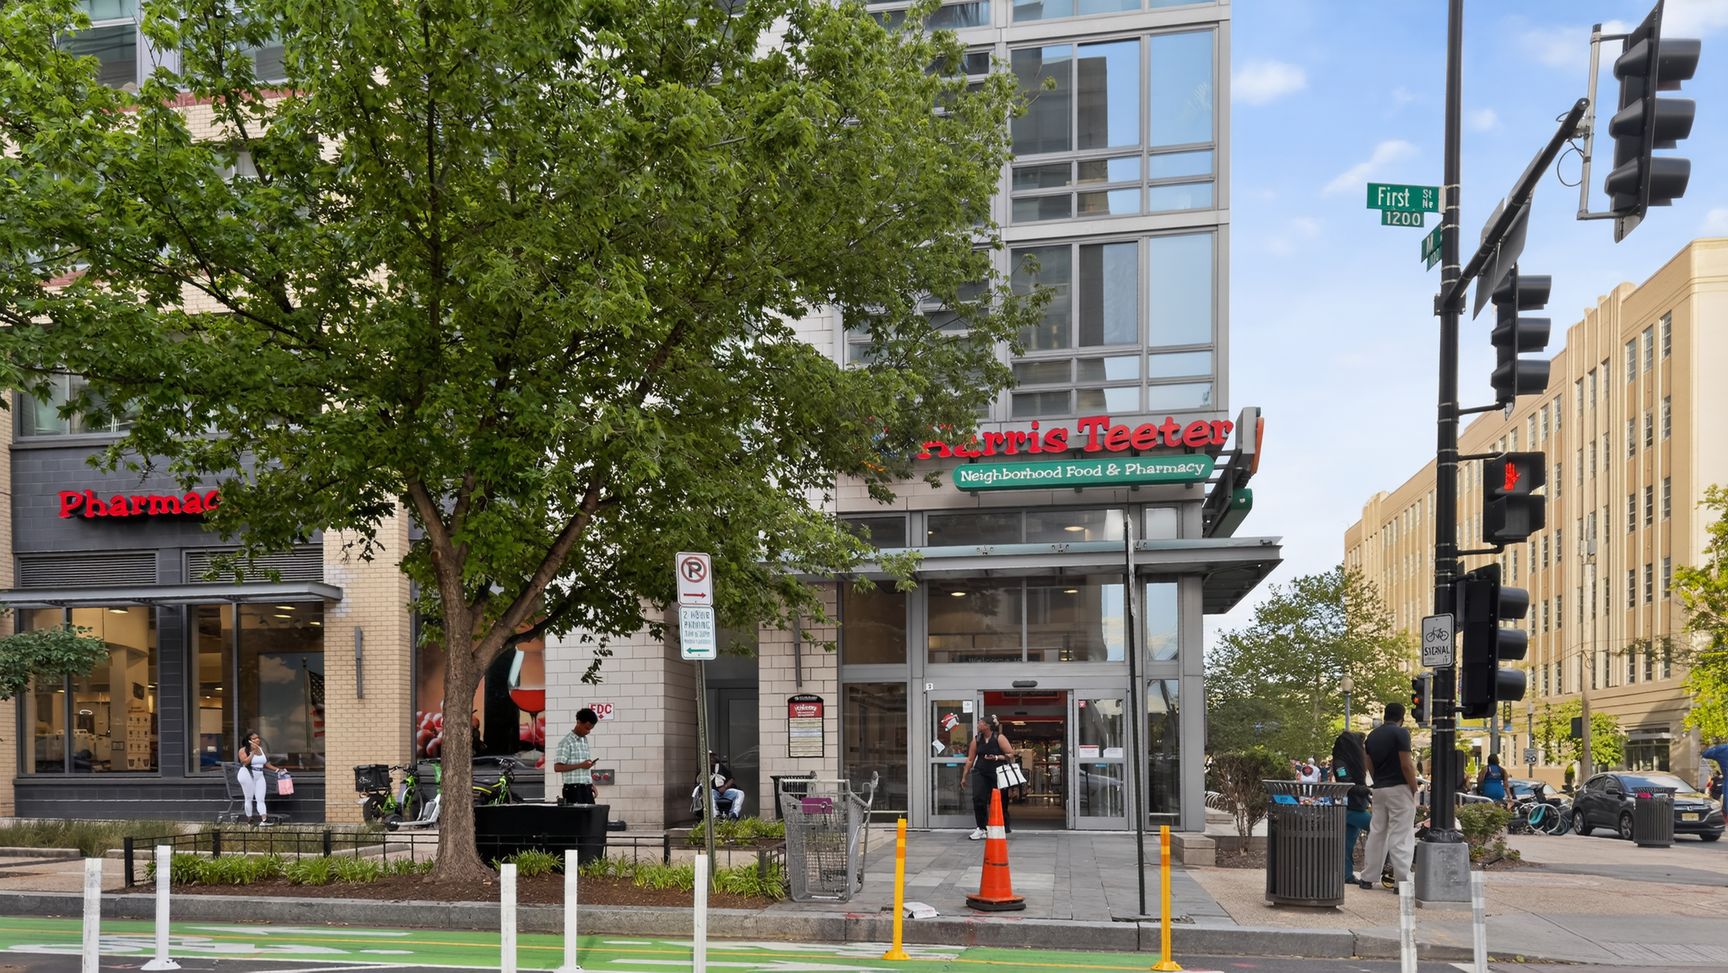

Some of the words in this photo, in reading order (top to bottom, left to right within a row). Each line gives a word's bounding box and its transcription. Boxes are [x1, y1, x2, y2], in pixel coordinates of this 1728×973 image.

[1378, 187, 1410, 207] First
[1422, 189, 1432, 199] St
[1386, 211, 1421, 226] 1200
[1426, 232, 1434, 257] M
[1077, 416, 1234, 453] Teeter
[960, 466, 1062, 484] Neighborhood
[1066, 465, 1102, 478] Food
[1105, 463, 1121, 476] &
[1125, 463, 1206, 476] Pharmacy
[57, 489, 222, 519] Pharmac
[1424, 645, 1450, 656] SIGNAL
